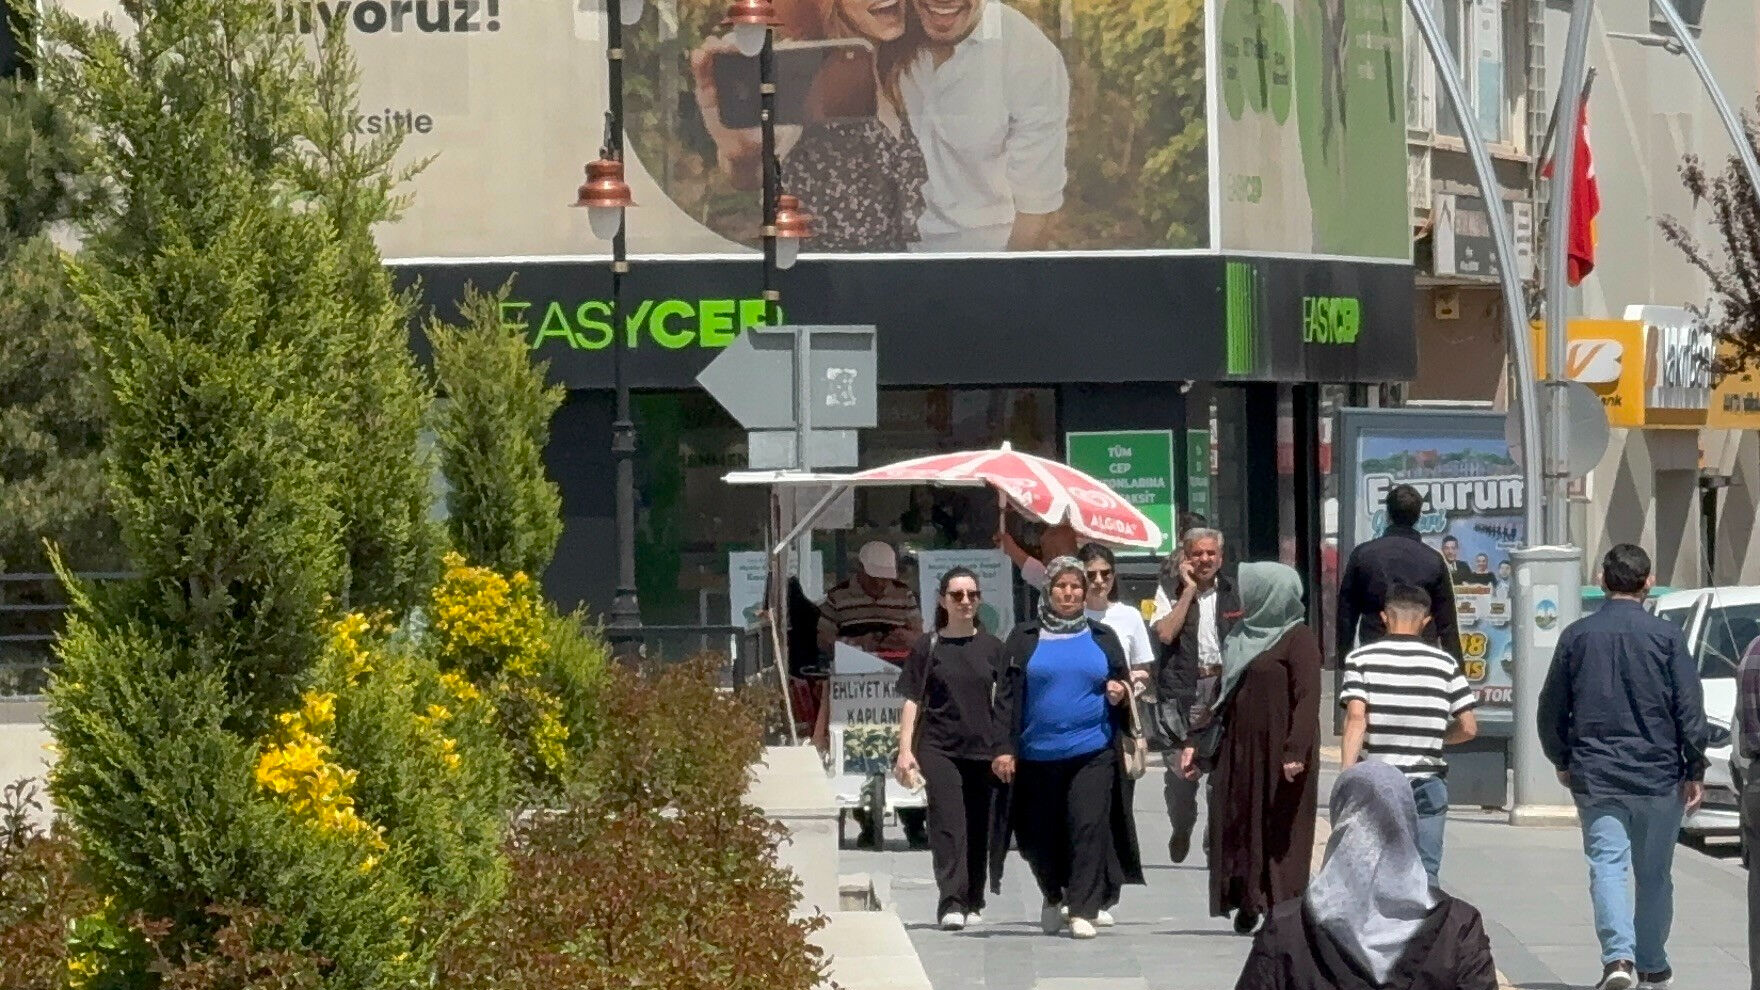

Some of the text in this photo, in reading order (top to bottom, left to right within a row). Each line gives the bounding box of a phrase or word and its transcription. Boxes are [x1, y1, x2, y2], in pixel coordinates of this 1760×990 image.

[1107, 444, 1132, 458] TÜM
[1108, 462, 1132, 474] CEP
[1101, 478, 1166, 488] ONLARINA
[1119, 490, 1156, 504] AKSİT
[1367, 478, 1524, 515] Ezuru
[1484, 688, 1513, 702] TOK
